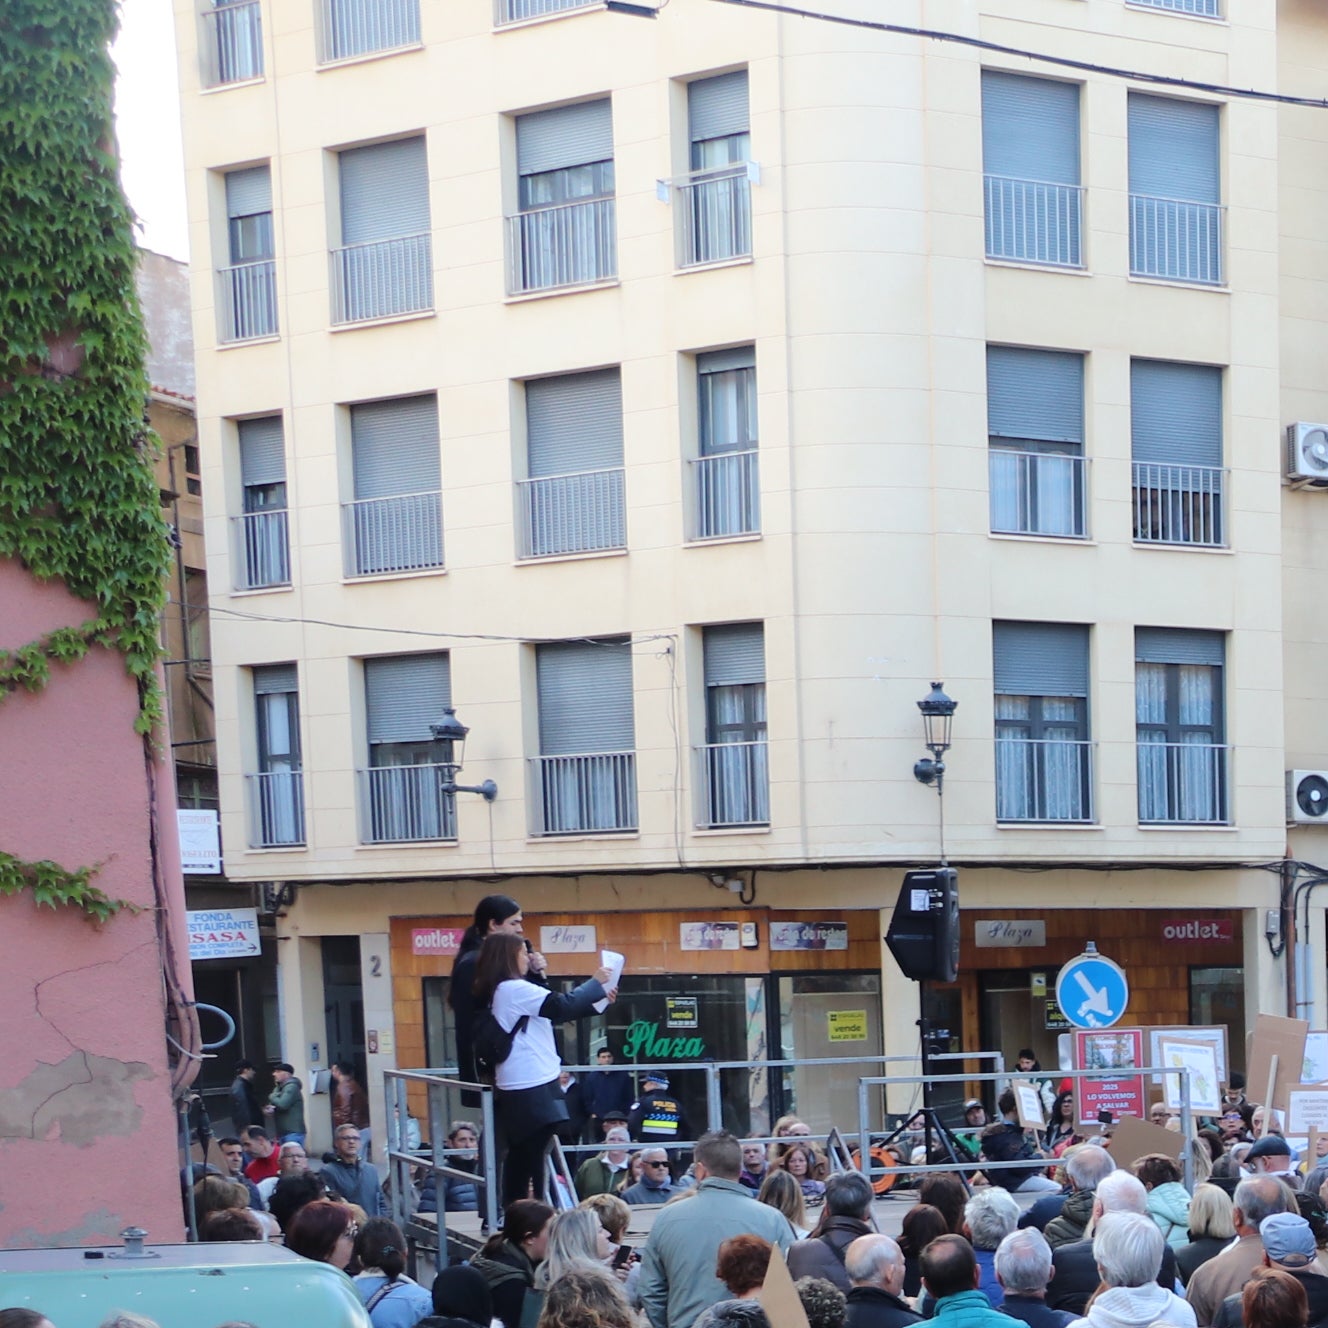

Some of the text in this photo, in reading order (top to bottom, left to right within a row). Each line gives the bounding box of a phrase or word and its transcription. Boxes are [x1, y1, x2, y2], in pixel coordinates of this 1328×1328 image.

[194, 912, 233, 922] FONDA
[551, 926, 588, 949] Plaza
[988, 922, 1033, 945] Plaza
[1163, 922, 1219, 939] outlet
[370, 956, 382, 977] 2
[834, 1024, 861, 1032] vende
[623, 1020, 705, 1058] Plaza
